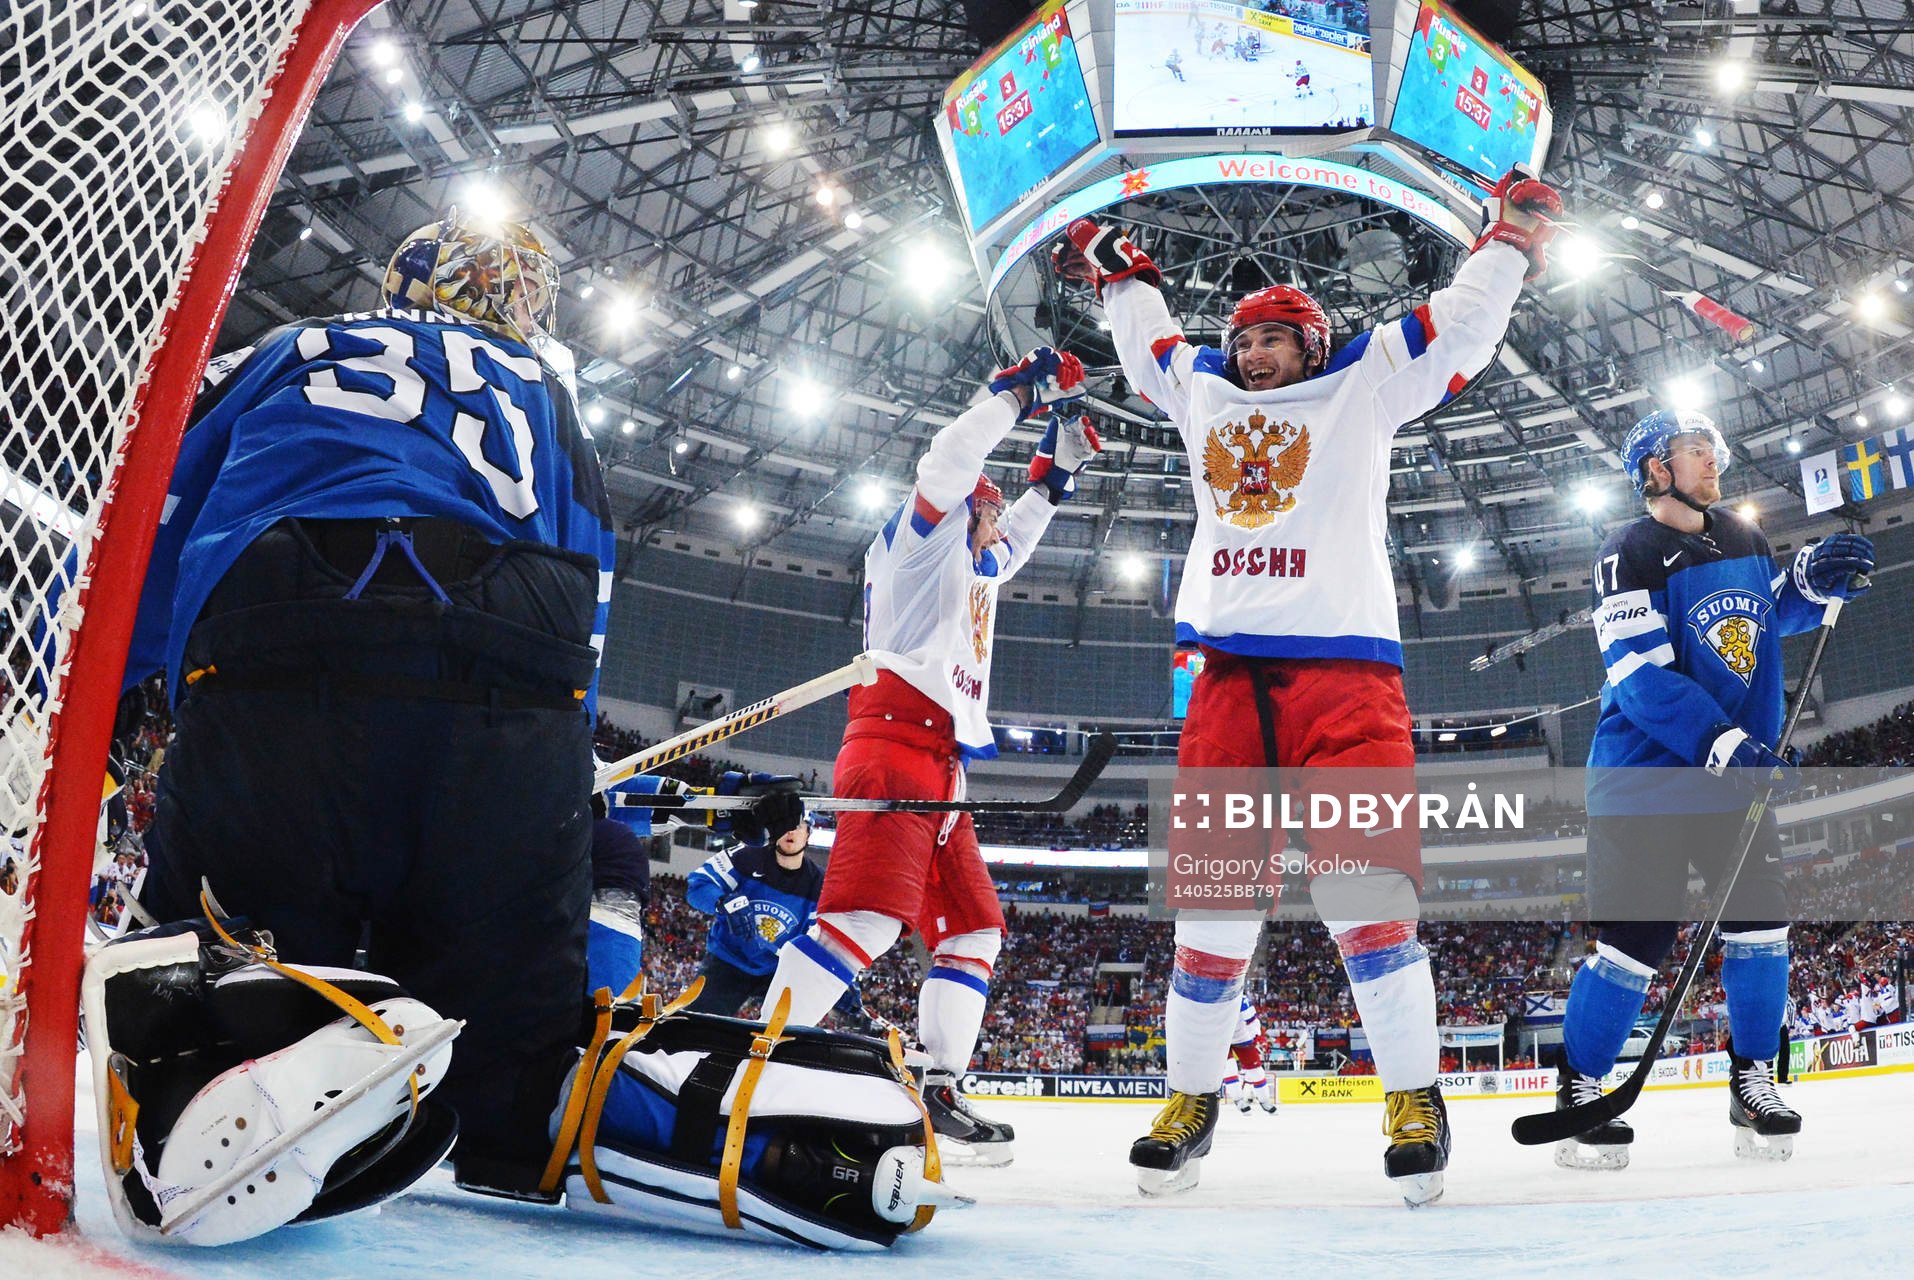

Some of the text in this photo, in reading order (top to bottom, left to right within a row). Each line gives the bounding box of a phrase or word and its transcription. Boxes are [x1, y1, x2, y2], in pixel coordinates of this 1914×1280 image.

[1021, 14, 1061, 54] Finland
[1431, 15, 1468, 53] Russia
[1048, 43, 1058, 62] 2
[1435, 44, 1445, 61] 3
[1004, 81, 1011, 93] 3
[1475, 75, 1482, 89] 3
[1501, 73, 1537, 111] Finland
[955, 79, 988, 112] Russia
[968, 110, 977, 126] 3
[998, 95, 1030, 131] 15:37
[1457, 90, 1491, 126] 15:37
[1516, 111, 1524, 128] 2
[1217, 127, 1271, 136] ПАЛАМИ
[1218, 158, 1358, 189] Welcome
[1369, 178, 1392, 199] to
[297, 326, 545, 520] 35
[1593, 553, 1620, 598] 47
[1696, 595, 1760, 627] SUOMI
[754, 903, 794, 925] SUOMI
[962, 1075, 1044, 1096] Ceresit
[1060, 1079, 1162, 1095] NIVEA MEN
[1321, 1078, 1374, 1088] Raiffeisen
[1515, 1076, 1549, 1090] IIHF
[1320, 1089, 1353, 1098] BANK
[833, 1165, 860, 1184] GR
